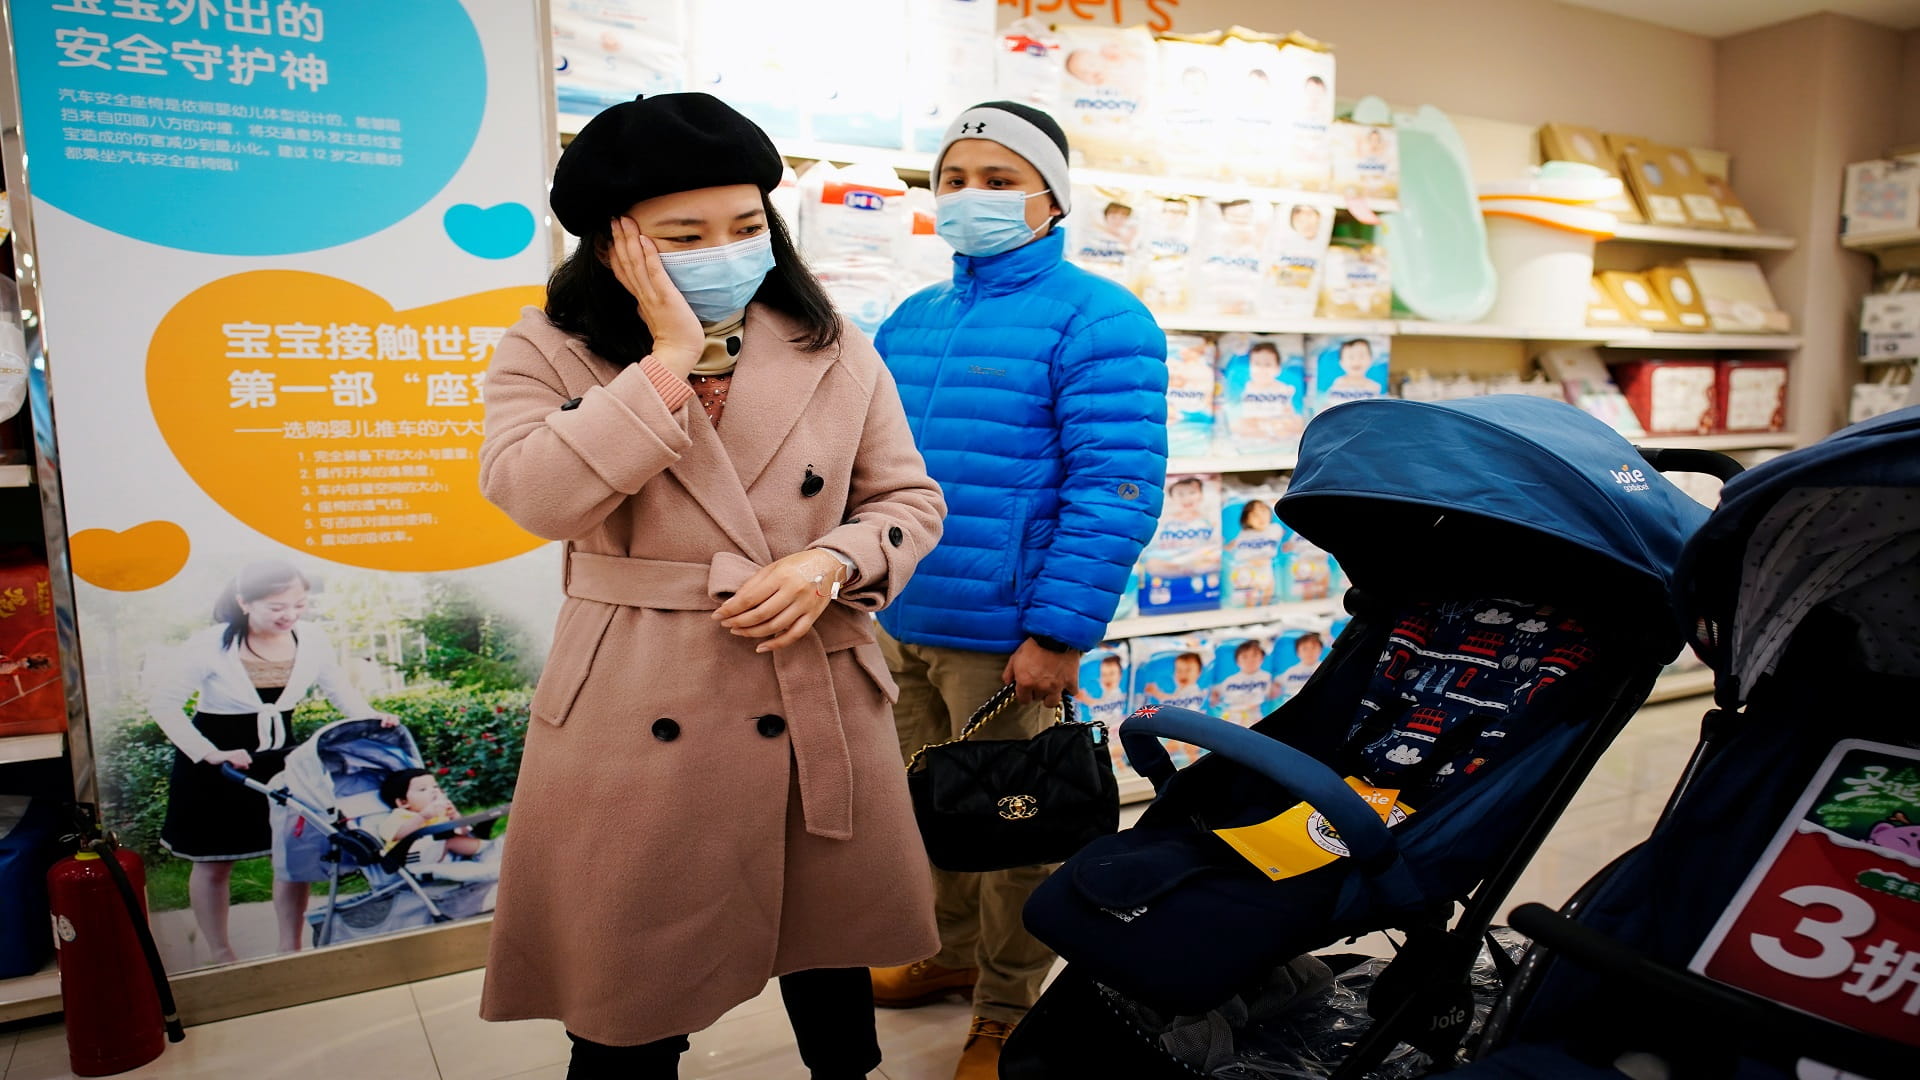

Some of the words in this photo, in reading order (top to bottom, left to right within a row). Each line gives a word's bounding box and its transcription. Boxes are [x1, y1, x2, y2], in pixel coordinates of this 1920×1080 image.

[56, 27, 328, 92] 安全守护神
[1074, 98, 1137, 114] moony
[313, 148, 327, 160] 12
[222, 321, 508, 362] 宝宝接触世界
[234, 419, 486, 440] ——选购婴儿推车的六大
[1609, 464, 1646, 484] Joie
[1160, 527, 1213, 540] moony
[1225, 681, 1268, 693] moony
[1358, 791, 1390, 805] oie
[1750, 884, 1920, 1017] 3折
[1429, 1005, 1465, 1031] Joie
